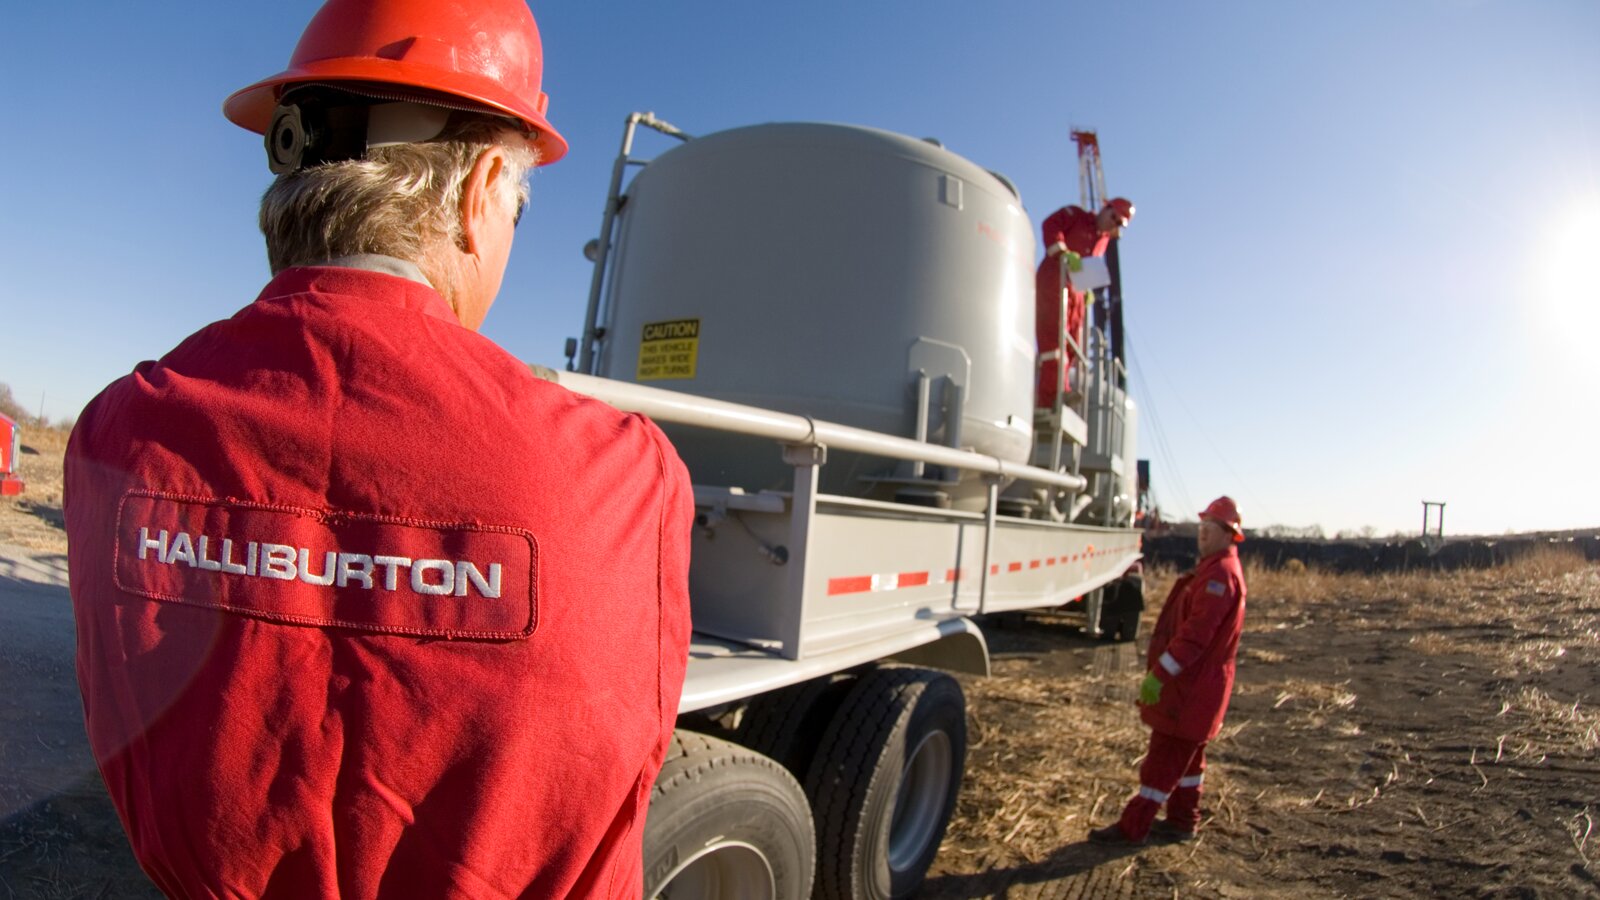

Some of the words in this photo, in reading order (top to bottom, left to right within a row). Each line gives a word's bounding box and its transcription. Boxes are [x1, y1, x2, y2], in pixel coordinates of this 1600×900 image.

[644, 322, 697, 340] CAUTION
[660, 342, 693, 353] VEHICLE
[138, 527, 502, 598] HALLIBURTON
